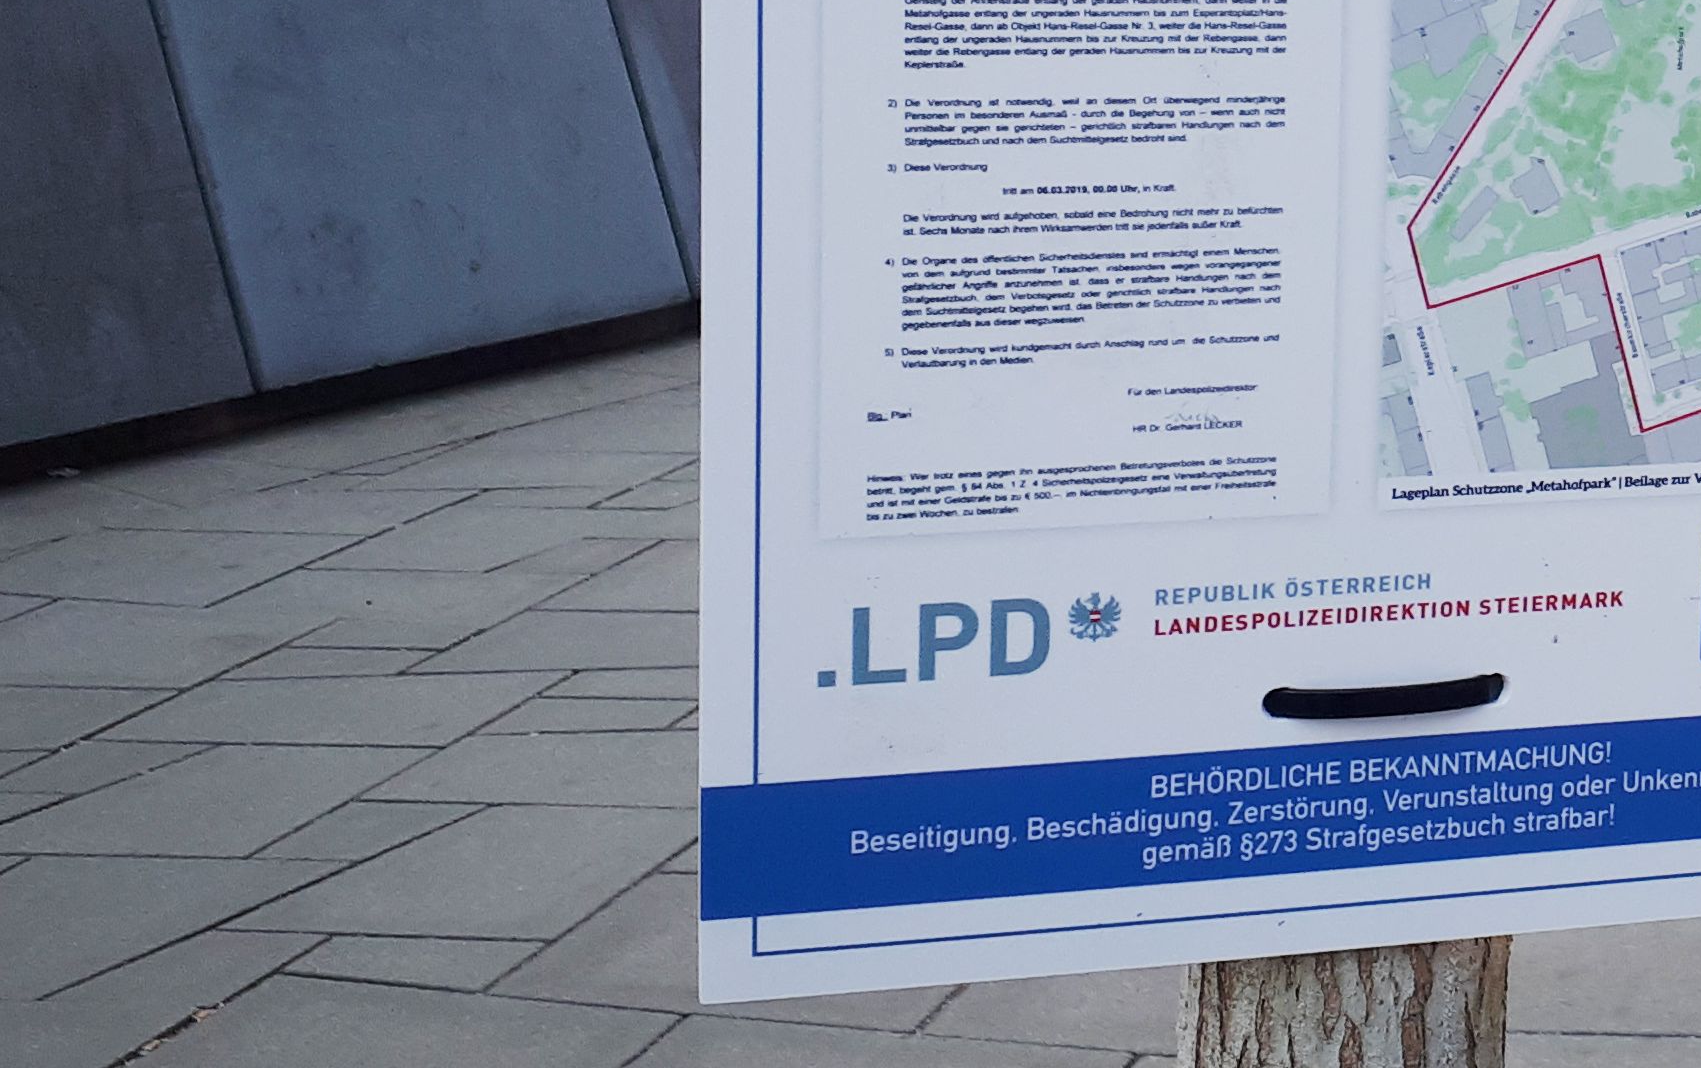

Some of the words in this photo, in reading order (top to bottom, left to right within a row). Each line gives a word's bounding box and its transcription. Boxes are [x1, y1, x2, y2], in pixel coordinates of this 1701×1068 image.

[887, 164, 897, 173] 3)
[904, 163, 931, 172] Diese
[933, 163, 988, 173] Verordnung
[903, 214, 919, 223] Die
[922, 213, 977, 223] Verordnung
[980, 212, 1000, 221] wird
[1064, 210, 1094, 219] sobald
[1120, 209, 1169, 219] Bedrohung
[1172, 208, 1194, 217] nicht
[1197, 208, 1220, 216] mehr
[1223, 208, 1234, 216] zu
[1237, 206, 1283, 215] befürchten
[884, 348, 894, 357] 5)
[901, 347, 929, 356] Diese
[931, 346, 986, 355] Verordnung
[989, 345, 1008, 353] wird
[1011, 343, 1072, 353] kundgemacht
[1075, 341, 1101, 349] durch
[1104, 340, 1145, 349] Anschlag
[1192, 337, 1206, 345] die
[1209, 335, 1260, 344] Schutzzone
[1263, 334, 1280, 342] und
[1392, 486, 1450, 501] Lageplan
[1452, 484, 1524, 496] Schutzzone
[1624, 475, 1669, 488] Beilage
[1671, 476, 1691, 485] zur
[1155, 583, 1275, 606] REPUBLIK
[1285, 573, 1431, 598] ÖSTERREICH
[1154, 600, 1470, 636] LANDESPOLIZEIDIREKTION
[1479, 591, 1623, 615] STEIERMARK
[818, 598, 1051, 688] .LPD
[1151, 761, 1341, 798] BEHÖRDLICHE
[1349, 741, 1611, 783] BEKANNTMACHUNG!
[1383, 781, 1553, 812] Verunstaltung
[1561, 774, 1616, 798] oder
[1142, 834, 1231, 870] gemäß
[1240, 829, 1298, 861] §273
[1306, 813, 1505, 852] Strafgesetzbuch
[1513, 803, 1615, 833] strafbar!
